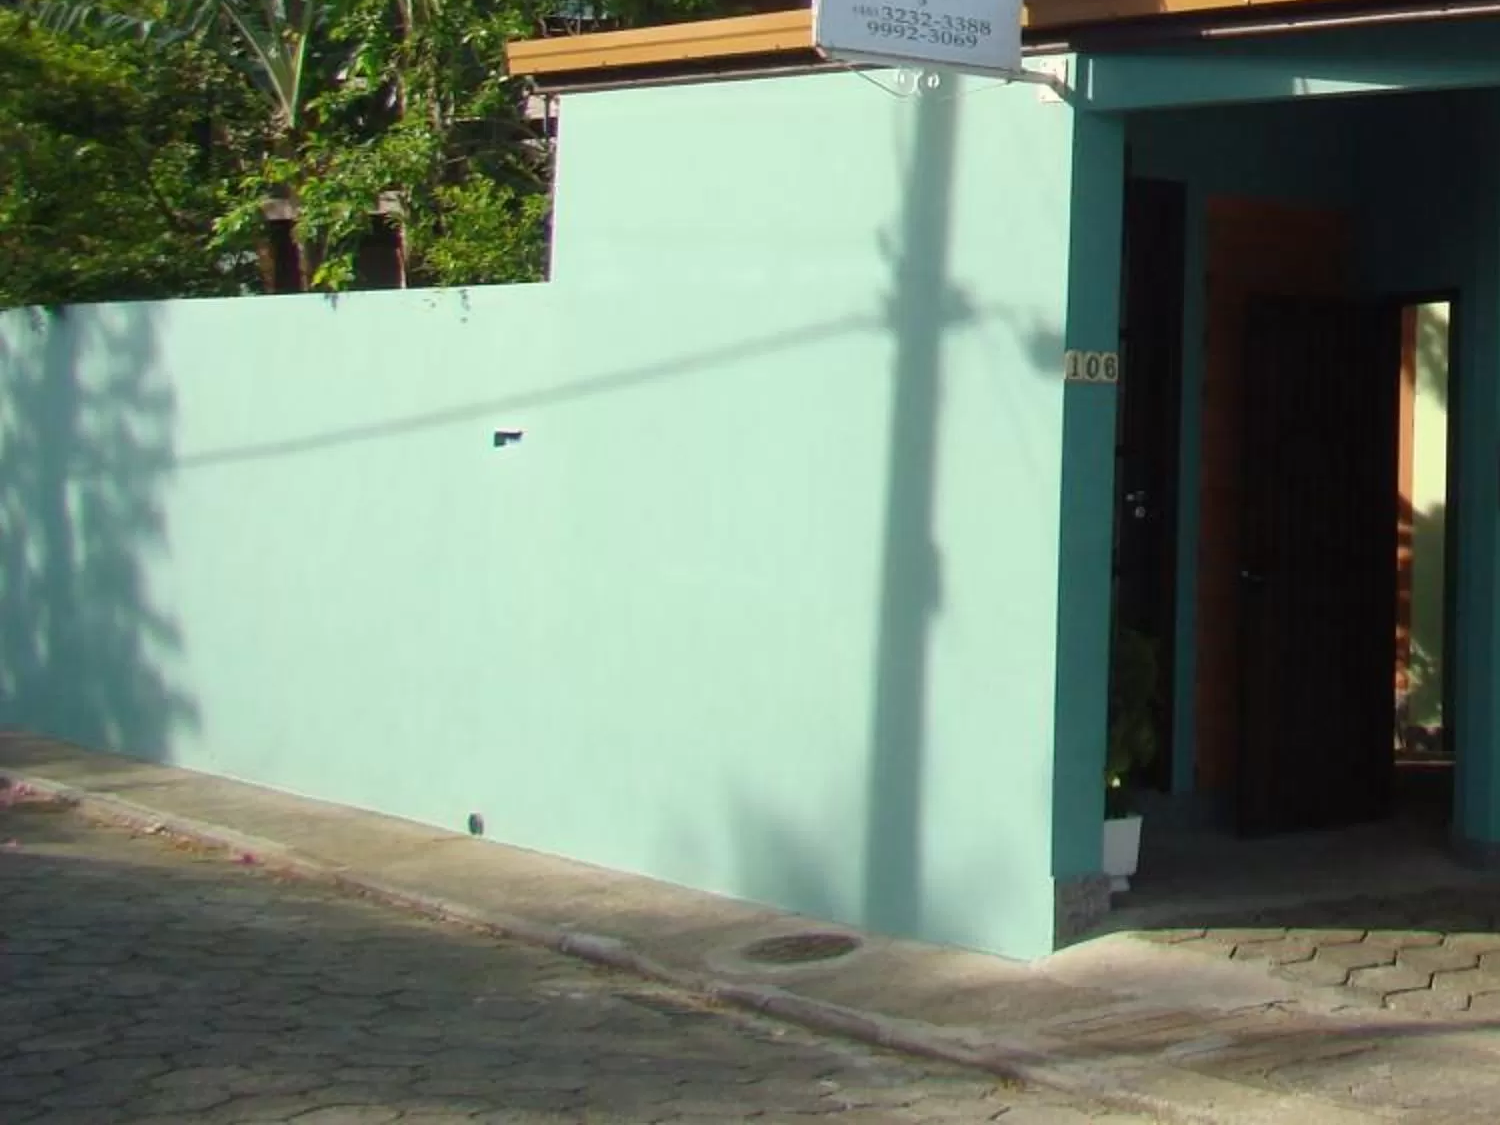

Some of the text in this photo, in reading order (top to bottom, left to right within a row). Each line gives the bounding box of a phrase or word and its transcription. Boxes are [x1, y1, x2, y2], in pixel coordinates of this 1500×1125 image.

[867, 20, 978, 48] 9992-3069
[881, 5, 992, 36] 3232-3388
[1070, 354, 1117, 380] 106
